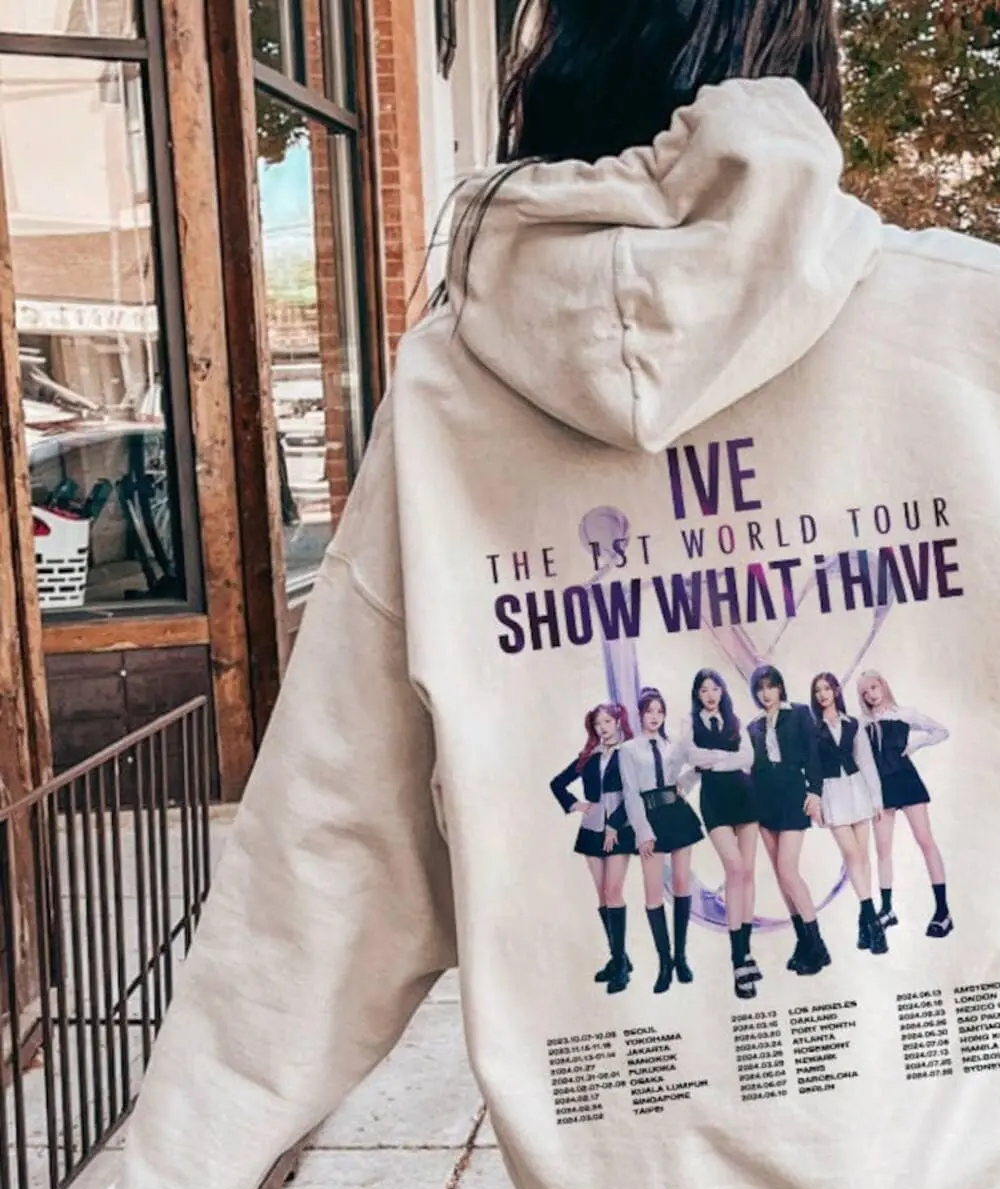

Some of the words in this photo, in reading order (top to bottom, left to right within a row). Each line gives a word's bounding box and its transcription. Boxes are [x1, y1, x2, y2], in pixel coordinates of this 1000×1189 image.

[666, 437, 762, 520] IVE
[486, 547, 557, 584] THE
[589, 535, 652, 571] 1ST
[681, 515, 816, 559] WORLD
[847, 497, 950, 538] TOUR
[494, 578, 641, 654] SHOW
[652, 558, 801, 633] WHAT
[838, 538, 964, 611] HAVE
[955, 993, 997, 1003] LONDON
[789, 1007, 808, 1015] LOS
[812, 1001, 857, 1012] ANGELES
[956, 1003, 995, 1013] MEXICO
[790, 1014, 838, 1025] OAKLAND
[820, 1021, 856, 1031] WORTH
[625, 1033, 682, 1046] YOKOHAMA
[793, 1034, 835, 1044] ATLANTA
[960, 1034, 989, 1043] HONG
[626, 1045, 671, 1056] JAKARTA
[961, 1043, 998, 1052] MANILA
[627, 1054, 677, 1066] BANGKOK
[796, 1065, 825, 1074] PARIS
[630, 1076, 664, 1086] OSAKA
[798, 1071, 858, 1084] BARCELONA
[631, 1083, 663, 1096] KUALA
[666, 1080, 708, 1091] LUMPUR
[633, 1092, 691, 1105] SINGAPORE
[633, 1106, 664, 1115] TAIPEI
